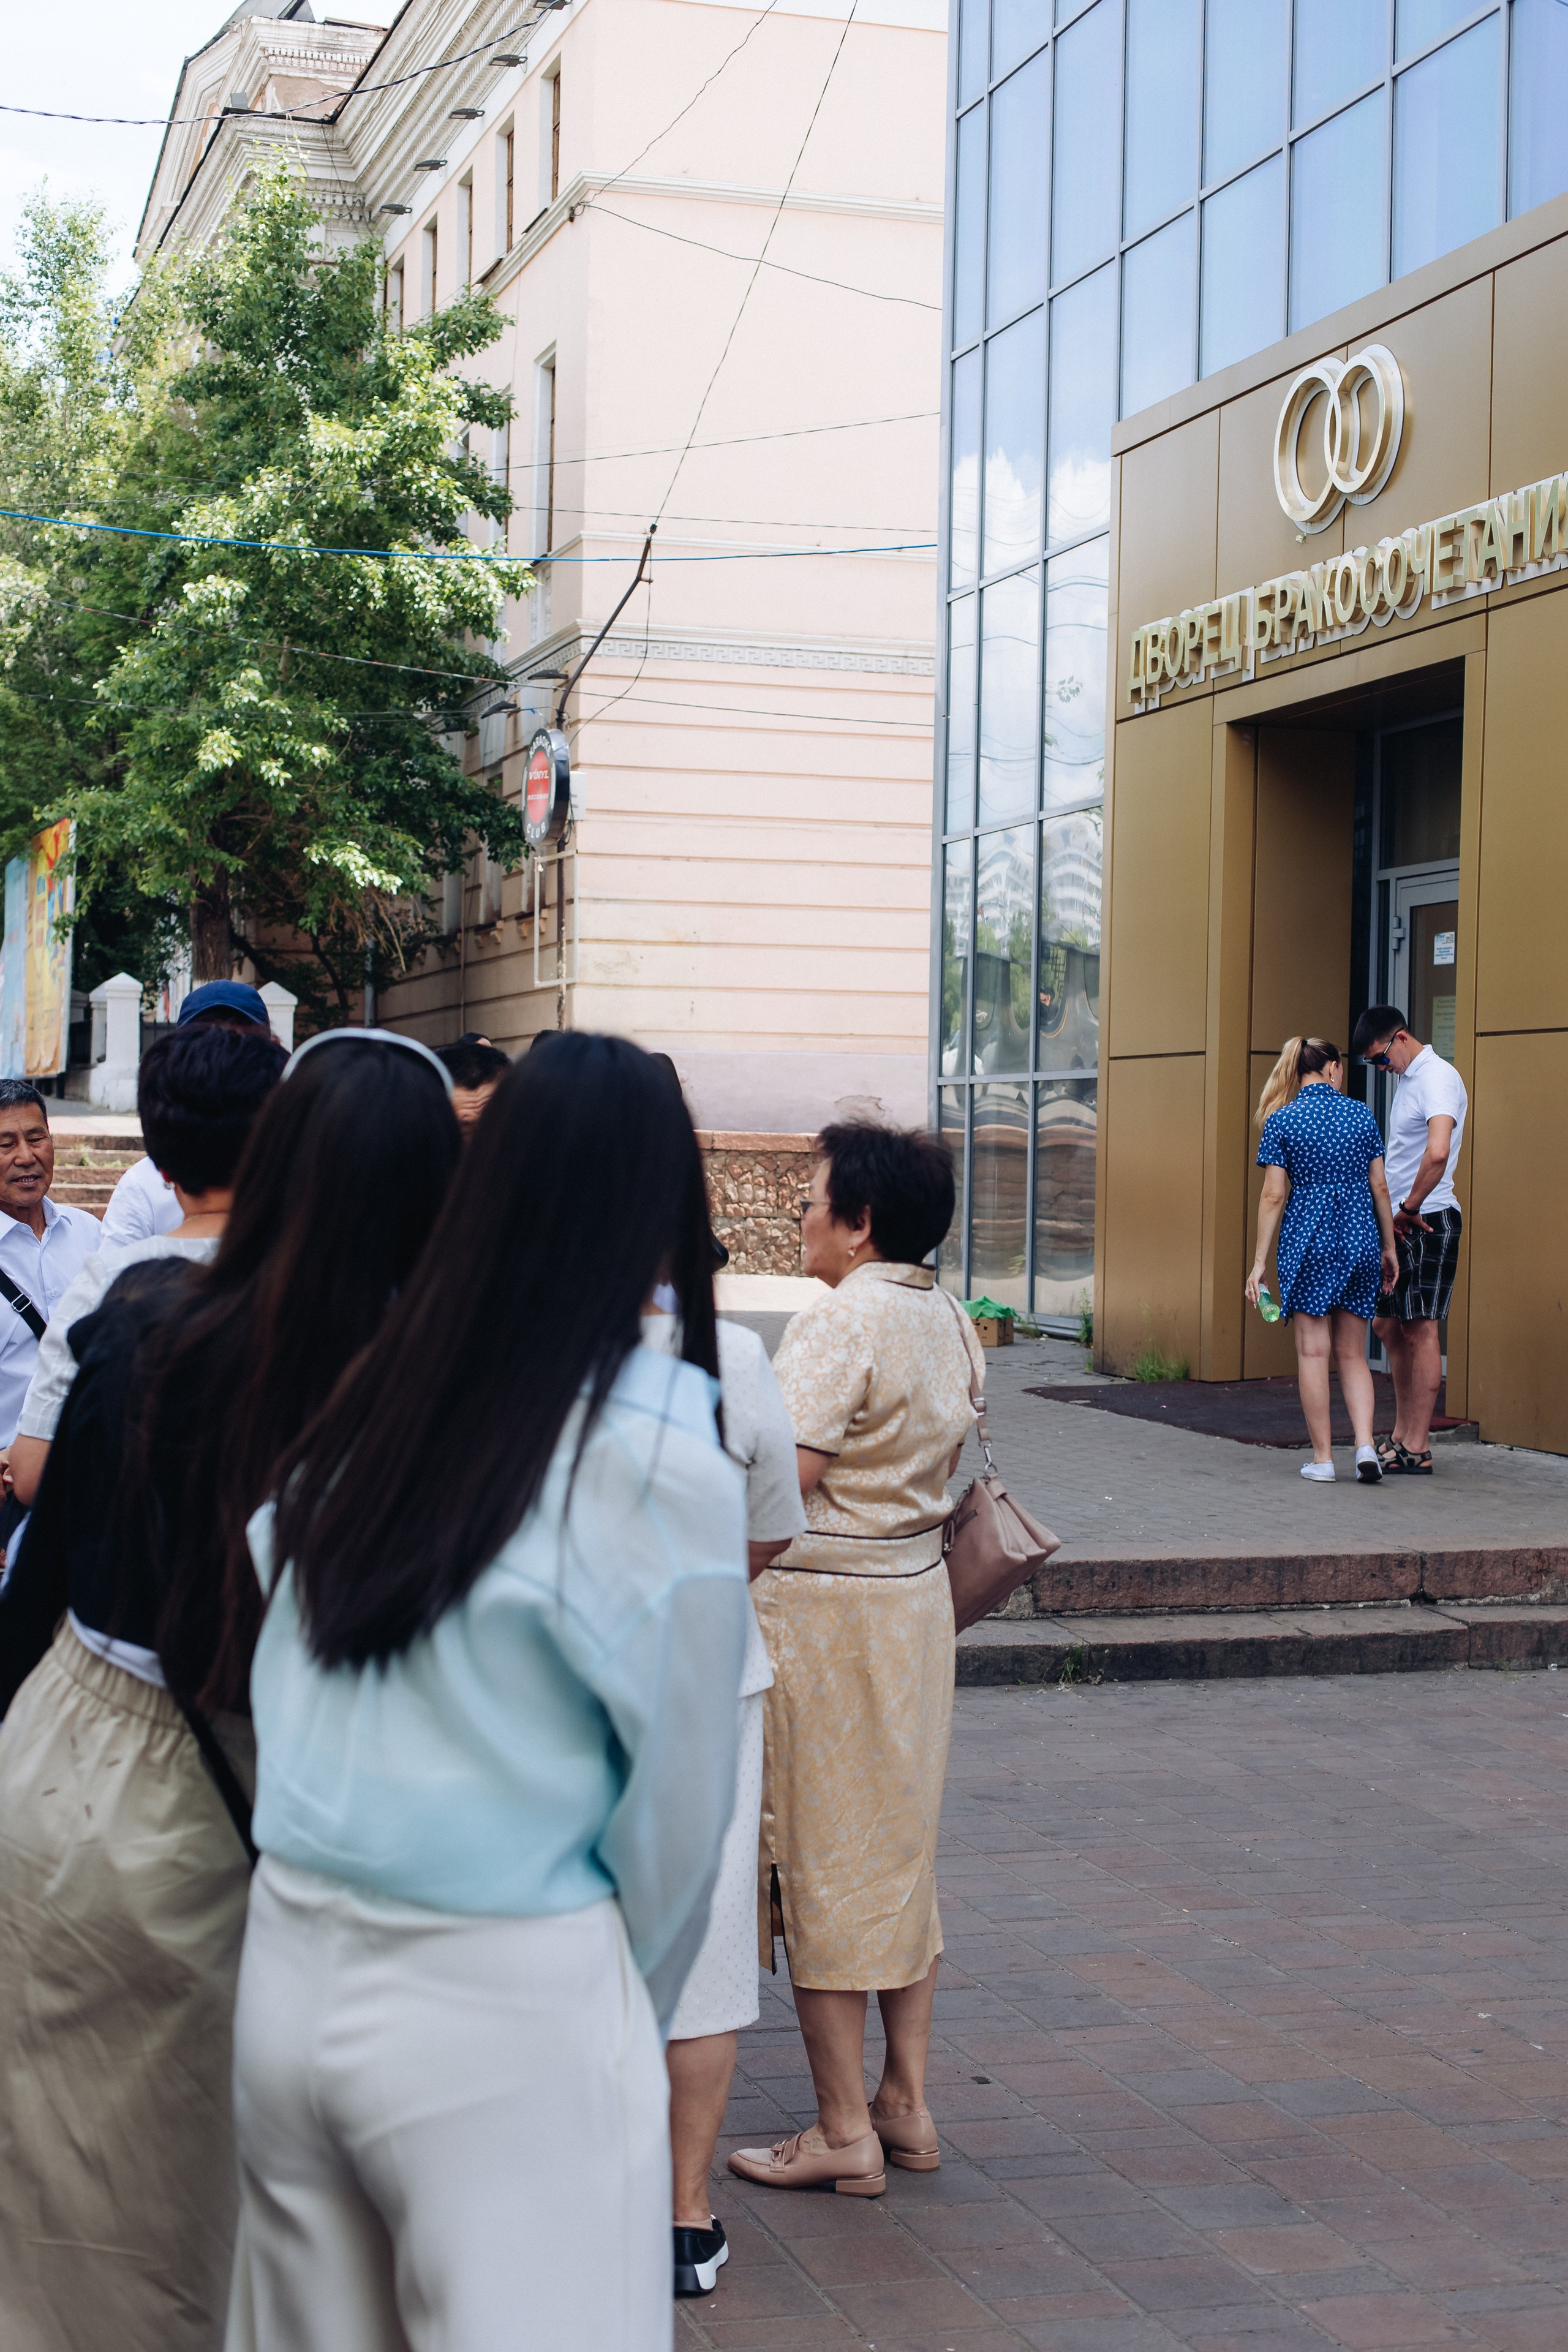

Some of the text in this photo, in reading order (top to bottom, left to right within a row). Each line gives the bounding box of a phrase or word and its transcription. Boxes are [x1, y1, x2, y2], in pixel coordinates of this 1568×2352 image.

[1127, 475, 1568, 706] ДВОРЕЦ БРАКОСОЧЕТАНИ
[529, 734, 551, 760] KARAOKE
[526, 821, 546, 839] CLUB
